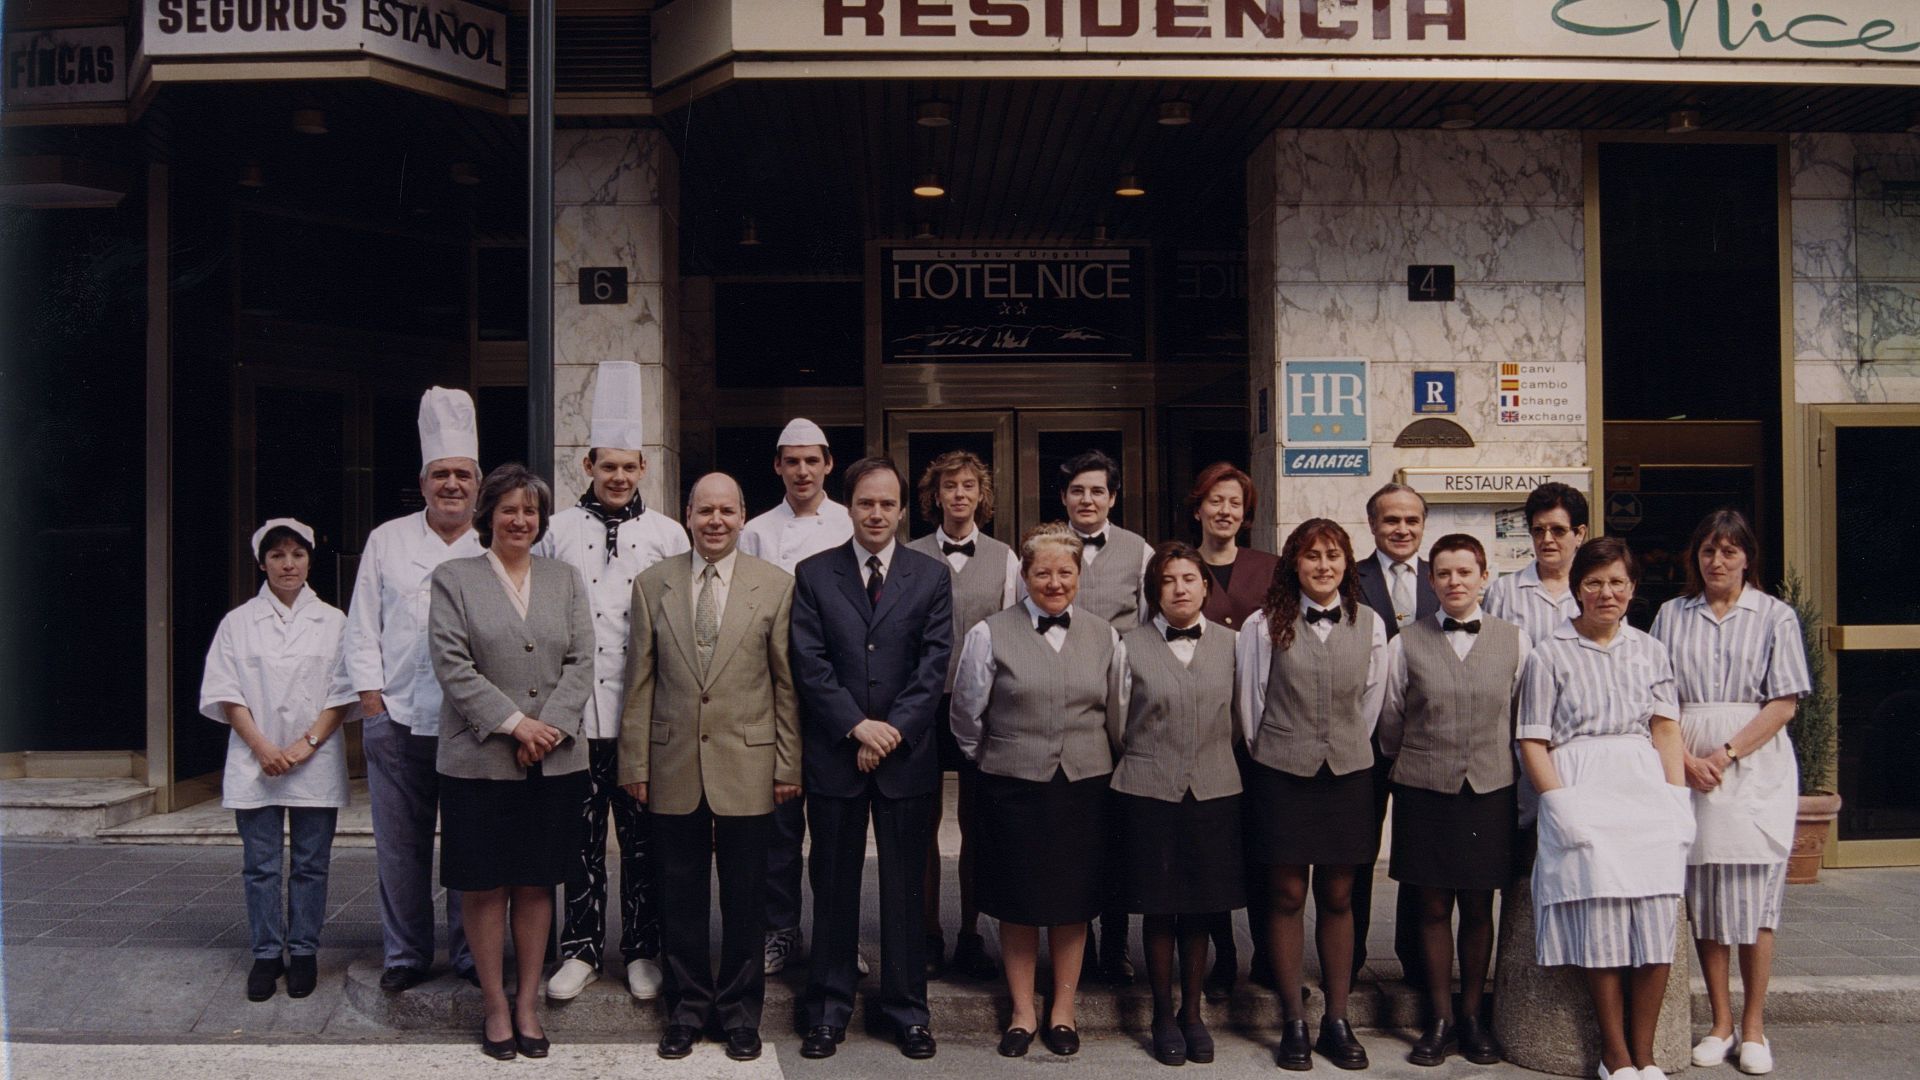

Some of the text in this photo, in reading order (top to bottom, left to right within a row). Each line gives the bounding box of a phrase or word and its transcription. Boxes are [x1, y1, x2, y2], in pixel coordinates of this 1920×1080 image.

[158, 0, 347, 34] SEGUROS
[824, 0, 1466, 40] RESIDENCIA
[362, 0, 502, 66] ESTAÑOL
[594, 270, 612, 300] 6
[893, 263, 1131, 300] HOTEL NICE
[1420, 267, 1437, 297] 4
[1521, 365, 1556, 374] canvi
[1289, 373, 1365, 416] HR
[1425, 381, 1447, 403] R
[1521, 381, 1569, 389] cambio
[1521, 397, 1569, 407] change
[1521, 412, 1582, 423] exchange
[1291, 454, 1364, 470] GARATGE
